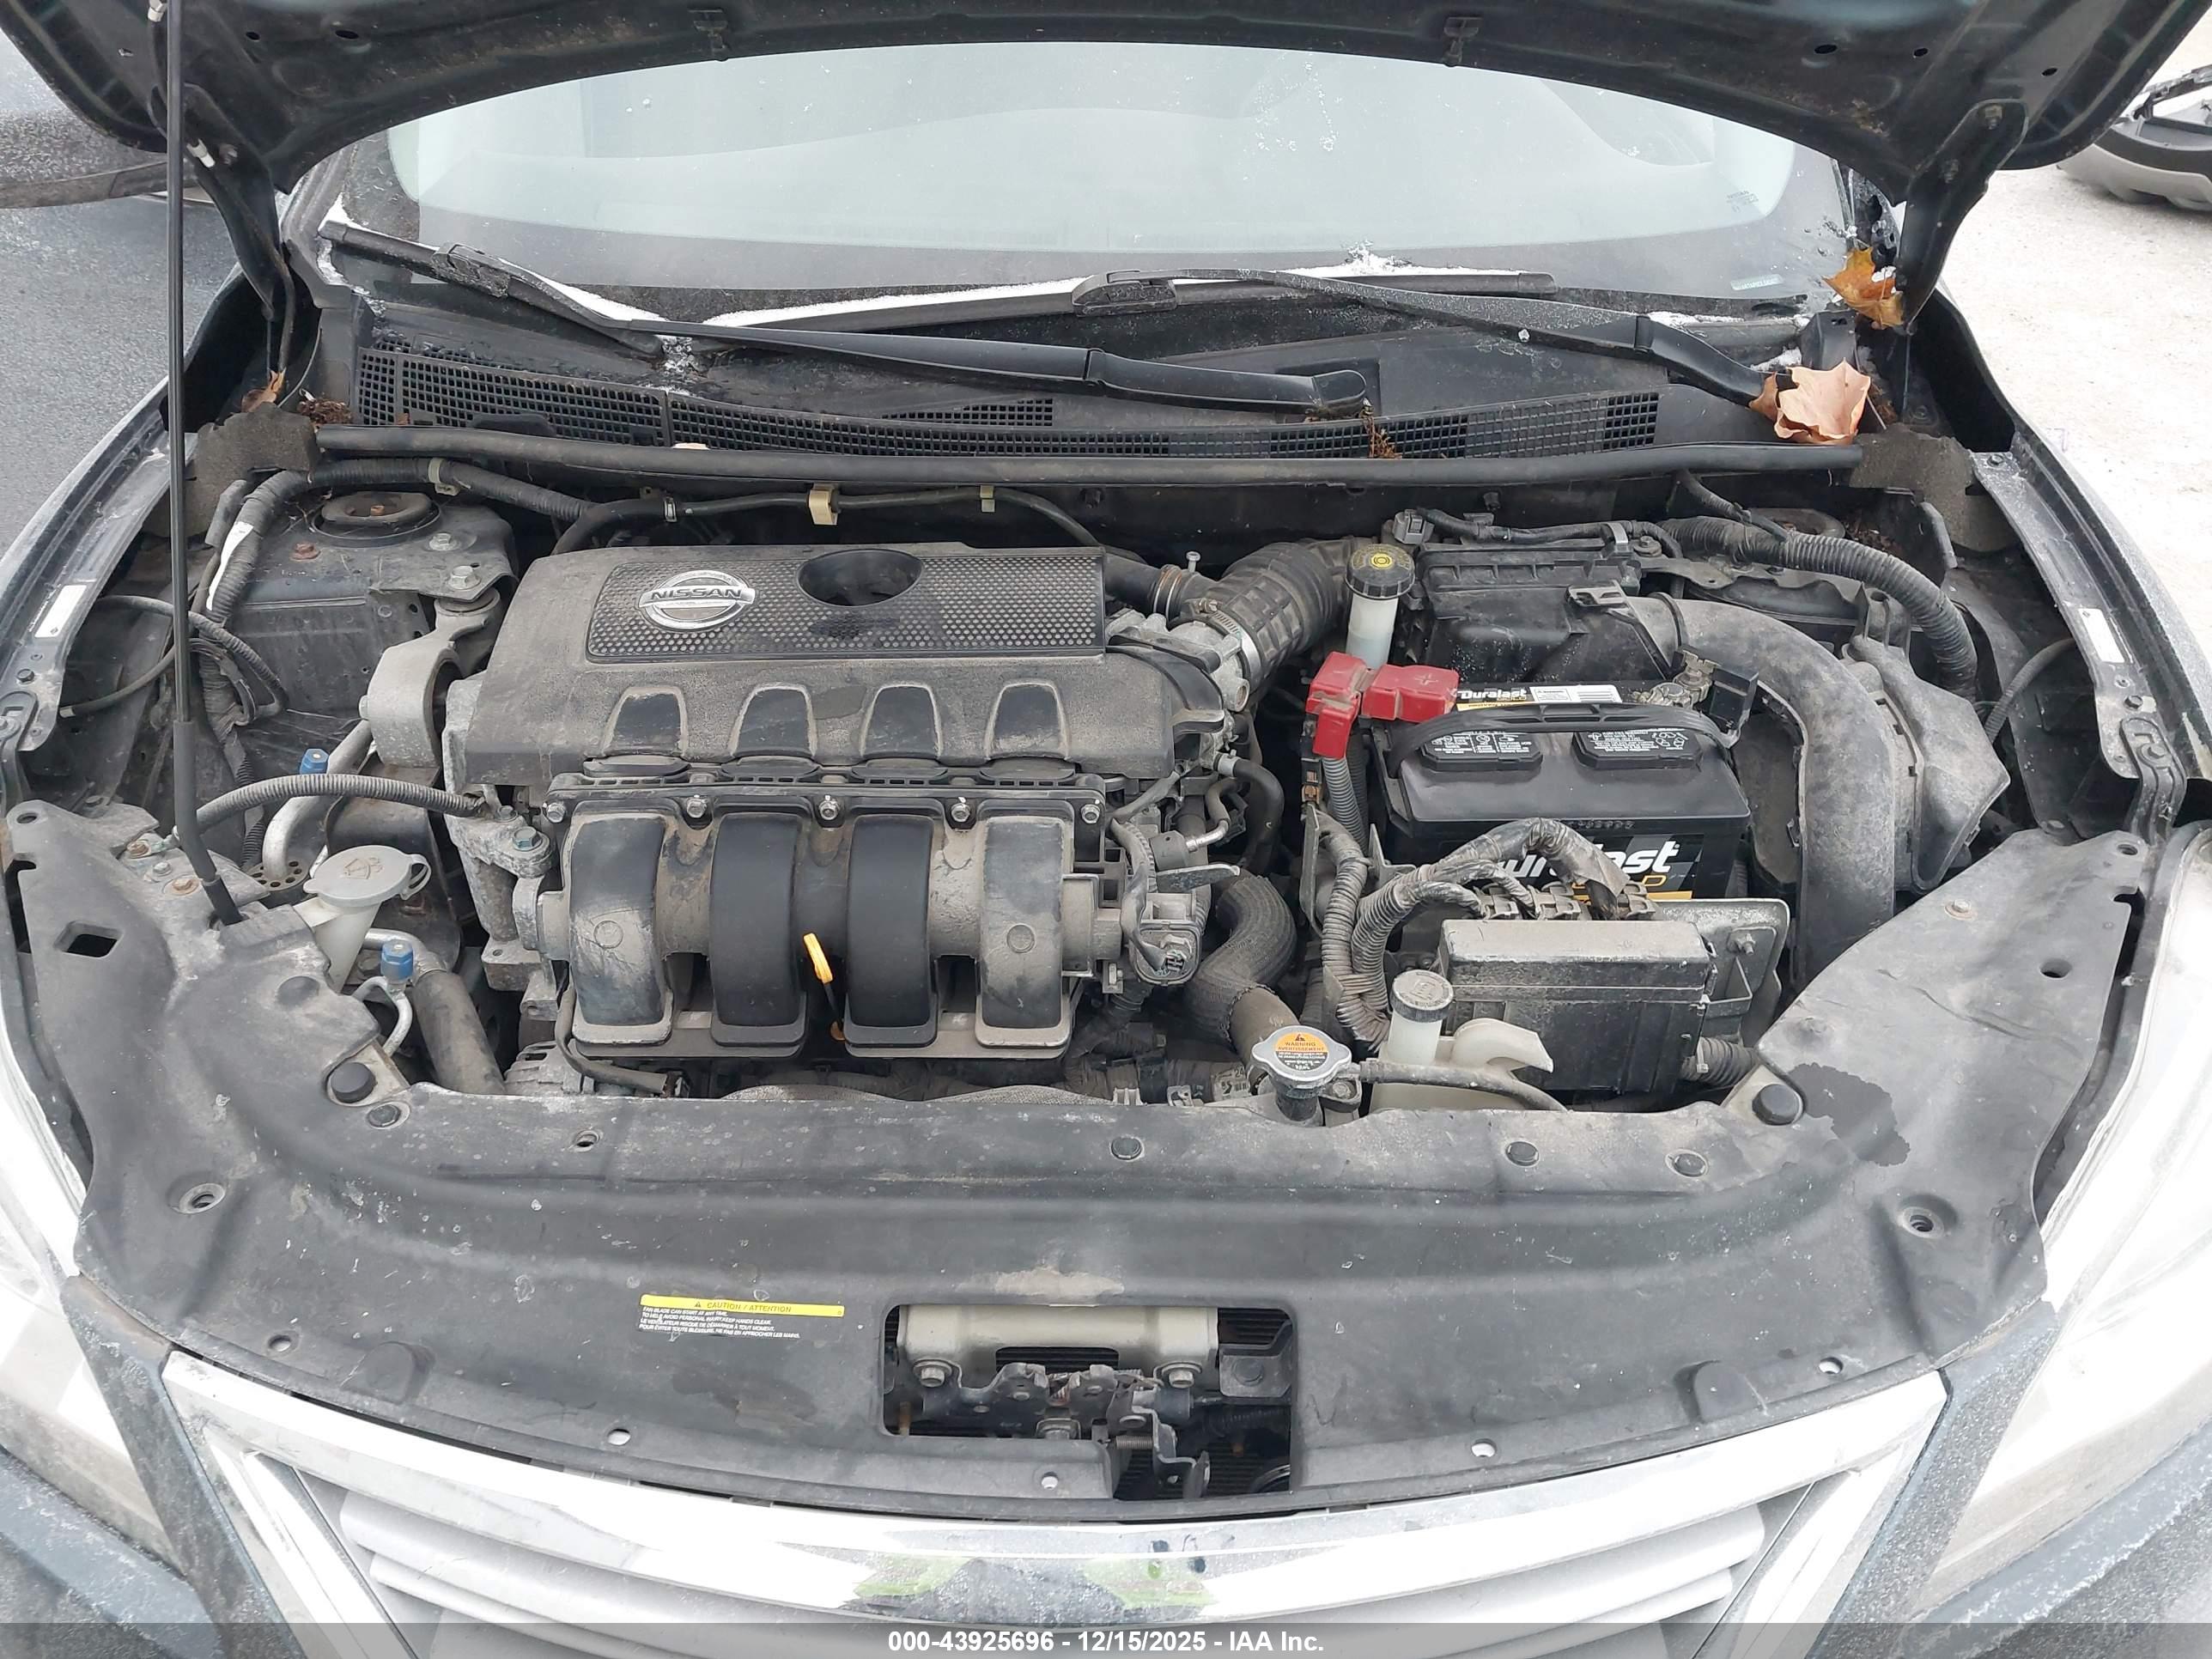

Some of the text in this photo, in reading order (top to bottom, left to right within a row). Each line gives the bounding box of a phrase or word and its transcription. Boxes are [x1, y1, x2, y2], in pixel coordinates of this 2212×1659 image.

[651, 587, 741, 599] NISSAN
[1457, 689, 1528, 700] Duralast
[707, 1302, 741, 1310] CAUTION
[749, 1304, 792, 1313] ATTENTION
